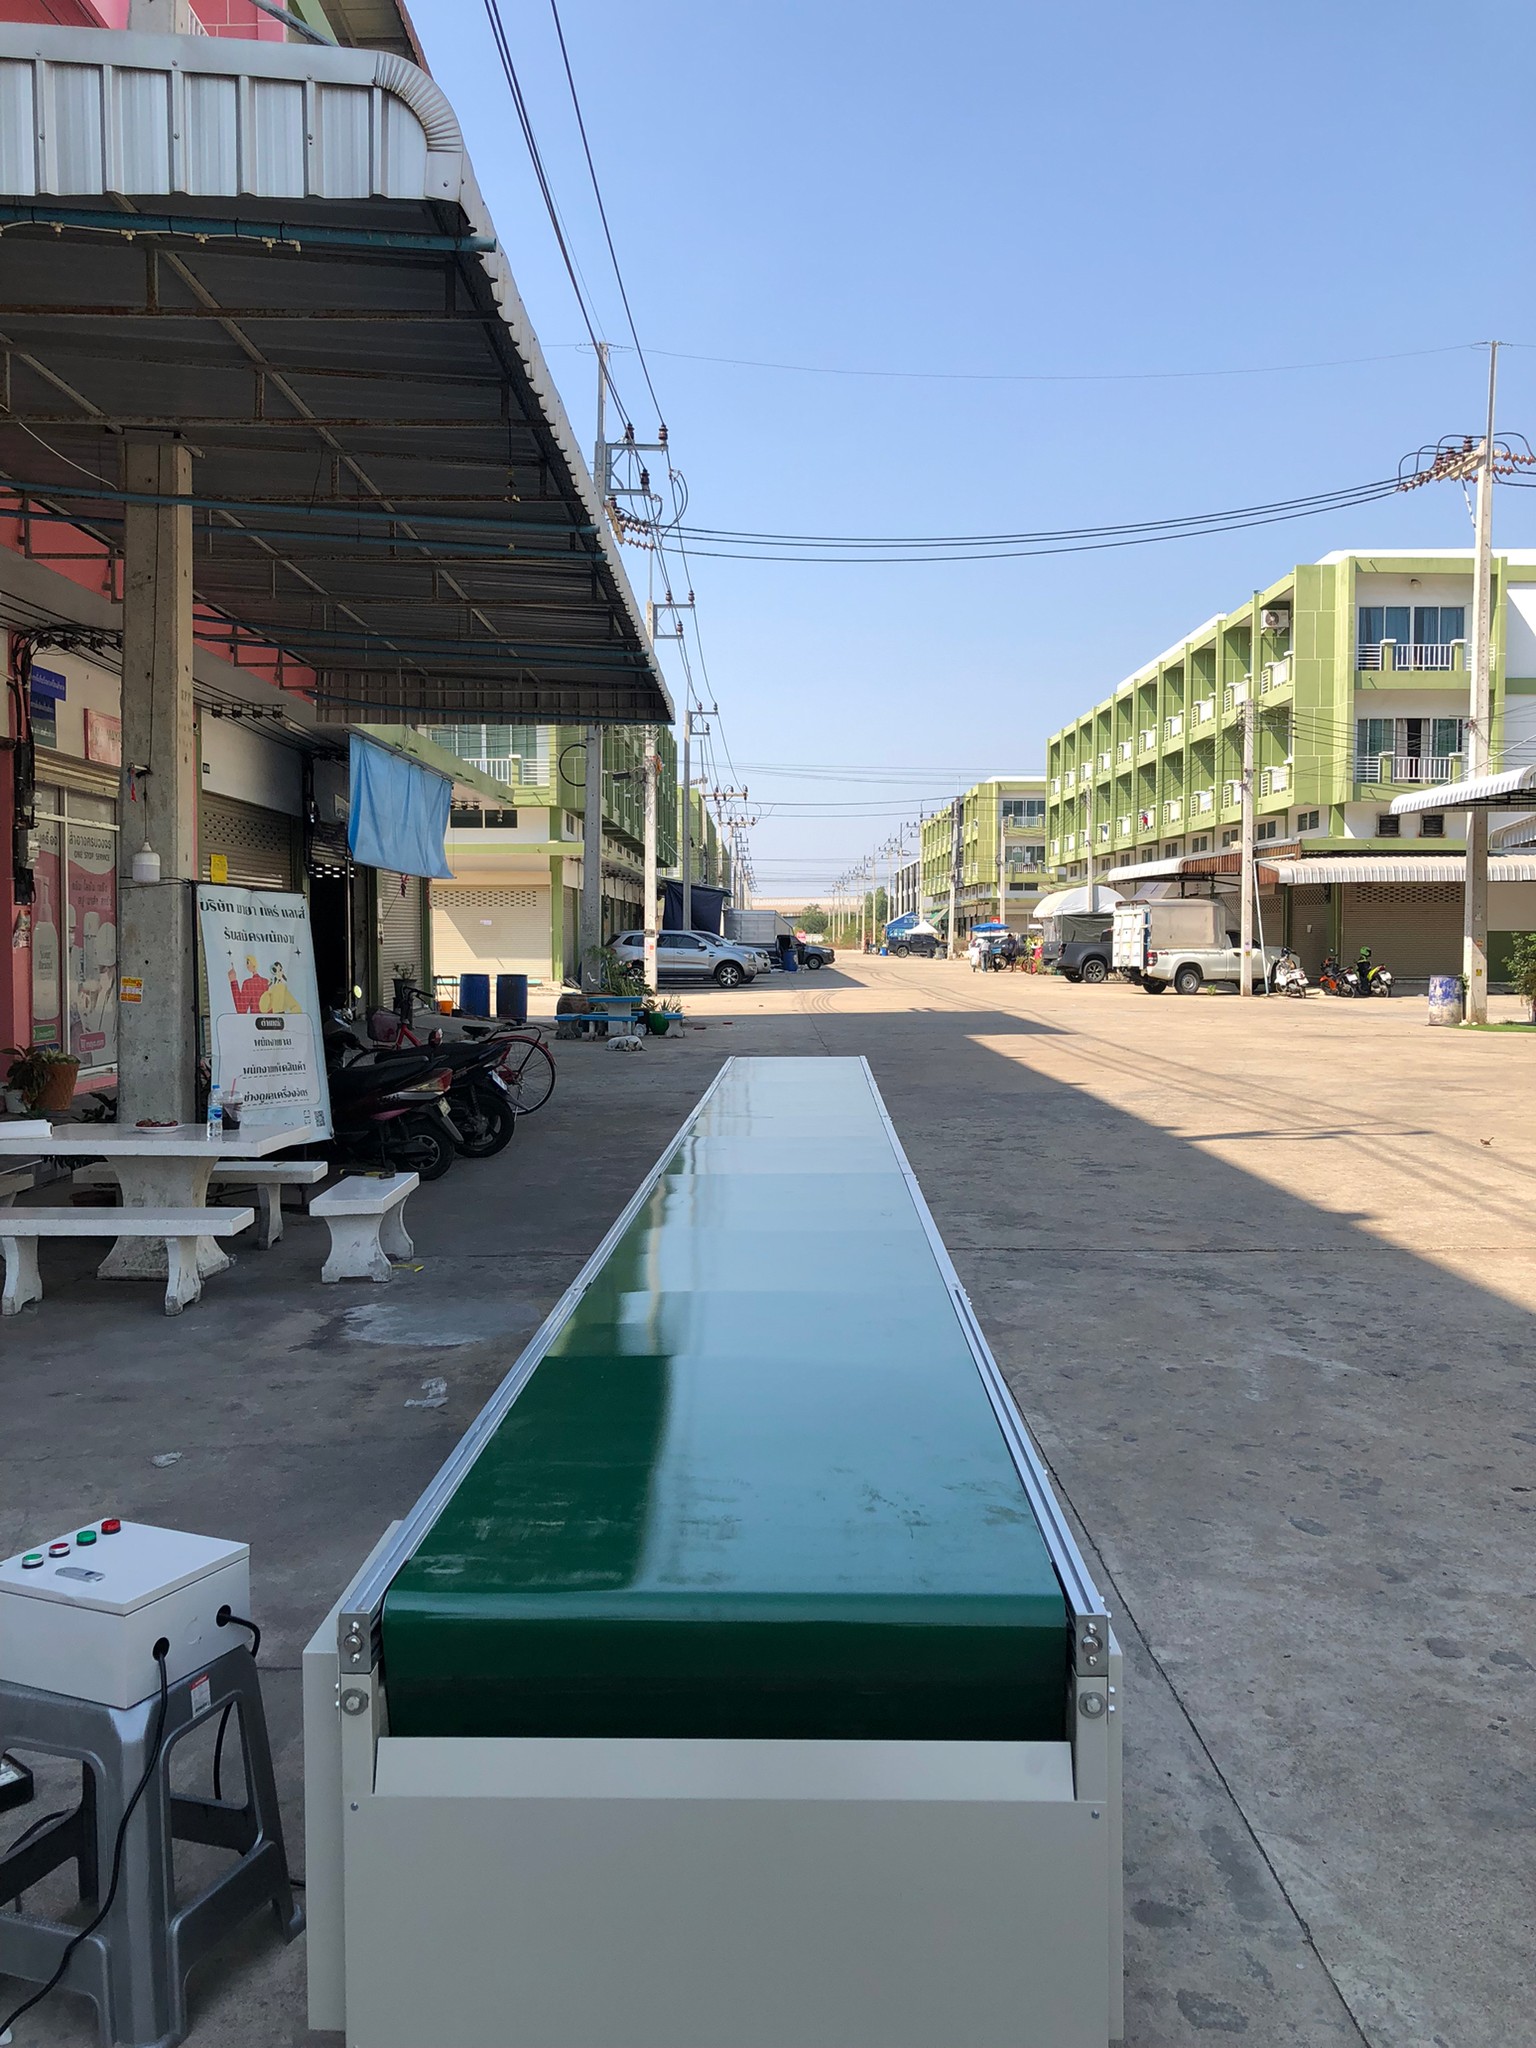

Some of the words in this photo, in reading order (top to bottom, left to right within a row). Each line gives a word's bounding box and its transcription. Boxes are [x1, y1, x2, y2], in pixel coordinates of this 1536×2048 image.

[74, 850, 83, 859] ONE
[84, 851, 94, 860] STOP
[95, 852, 110, 862] SERVICE
[200, 898, 234, 913] บริษัท
[224, 926, 295, 944] รับสมัครพนักงาน
